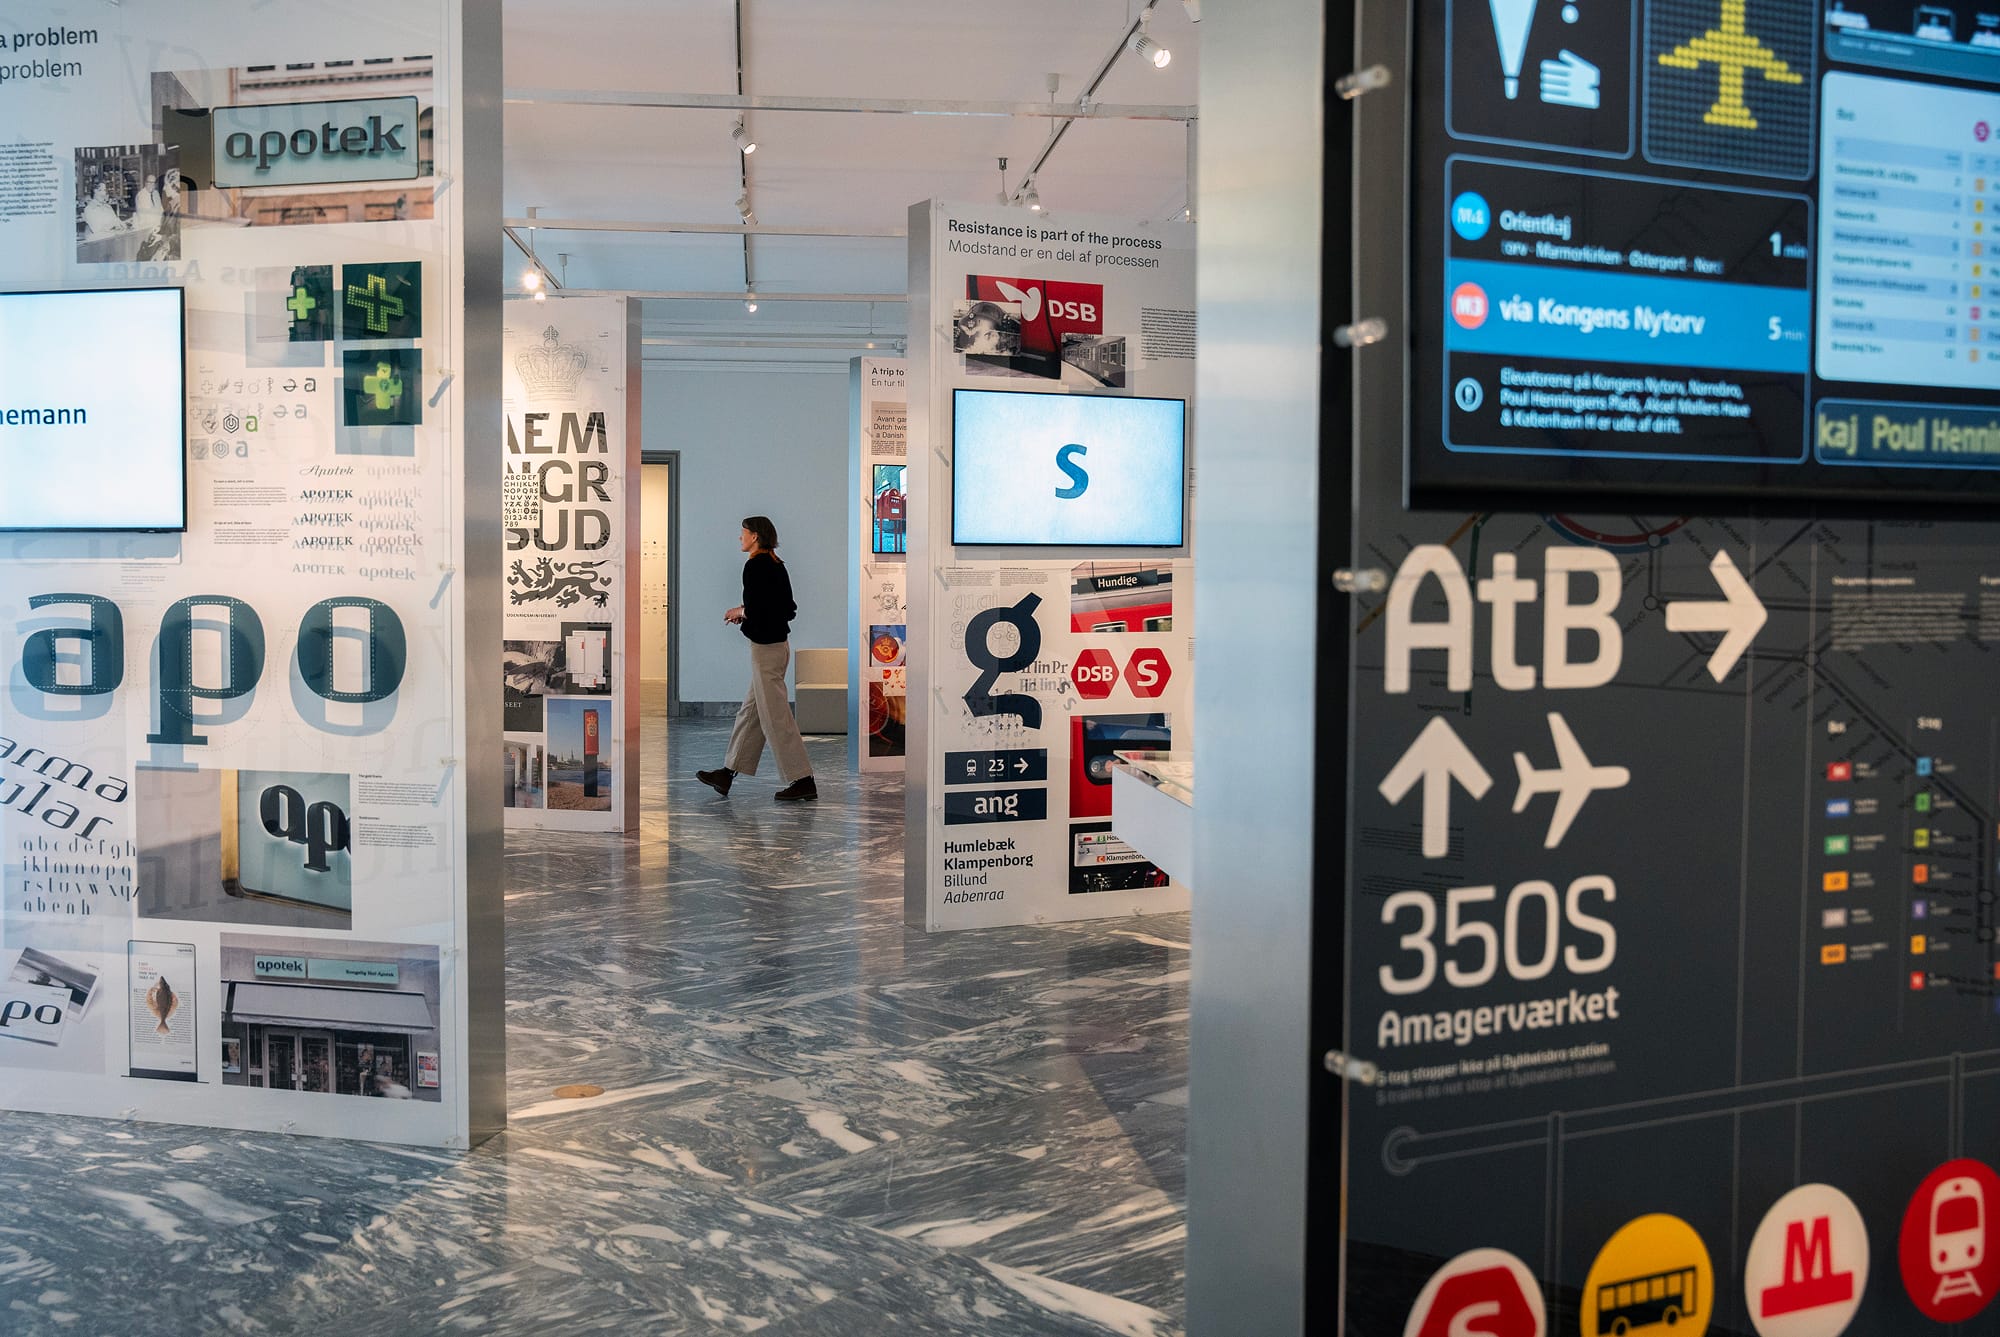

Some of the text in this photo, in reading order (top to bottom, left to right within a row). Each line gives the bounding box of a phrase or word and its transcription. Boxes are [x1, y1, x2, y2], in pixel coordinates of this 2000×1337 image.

[14, 26, 98, 53] problem
[0, 58, 82, 85] problem
[224, 115, 407, 171] apotek
[949, 219, 1163, 250] Resistance is part of the process
[1500, 208, 1572, 241] Orientkaj
[1769, 230, 1783, 258] 1
[948, 239, 1160, 269] Modstand er en del af processen
[1047, 300, 1097, 323] DSB
[1499, 294, 1533, 323] via
[1537, 297, 1631, 334] Kongens
[1634, 304, 1706, 339] Nytorv
[1768, 315, 1782, 342] 5
[871, 367, 905, 377] A trip to
[871, 378, 905, 388] En tur til
[1592, 372, 1645, 396] Kongens
[874, 423, 893, 431] Dutch
[876, 415, 896, 423] Avant
[882, 431, 905, 439] Danish
[1817, 412, 1860, 457] kaj
[1871, 415, 1927, 451] Poul
[1055, 443, 1090, 500] S
[300, 489, 353, 499] APOTEK
[300, 513, 353, 523] APOTEK
[301, 536, 354, 546] APOTEK
[1097, 575, 1138, 589] Hundige
[1384, 543, 1623, 694] AtB
[23, 592, 407, 746] apo
[1077, 665, 1114, 683] DSB
[1136, 659, 1160, 687] S
[988, 758, 1005, 772] 23
[974, 793, 1019, 817] ang
[260, 784, 352, 873] ap
[944, 837, 1016, 854] Humlebæk
[944, 854, 1034, 871] Klampenborg
[944, 872, 987, 888] Billund
[944, 890, 1005, 905] Aabenraa
[1378, 874, 1617, 996] 350S
[256, 960, 304, 973] apotek
[1377, 986, 1620, 1049] Amagerværket
[1569, 1042, 1611, 1060] station
